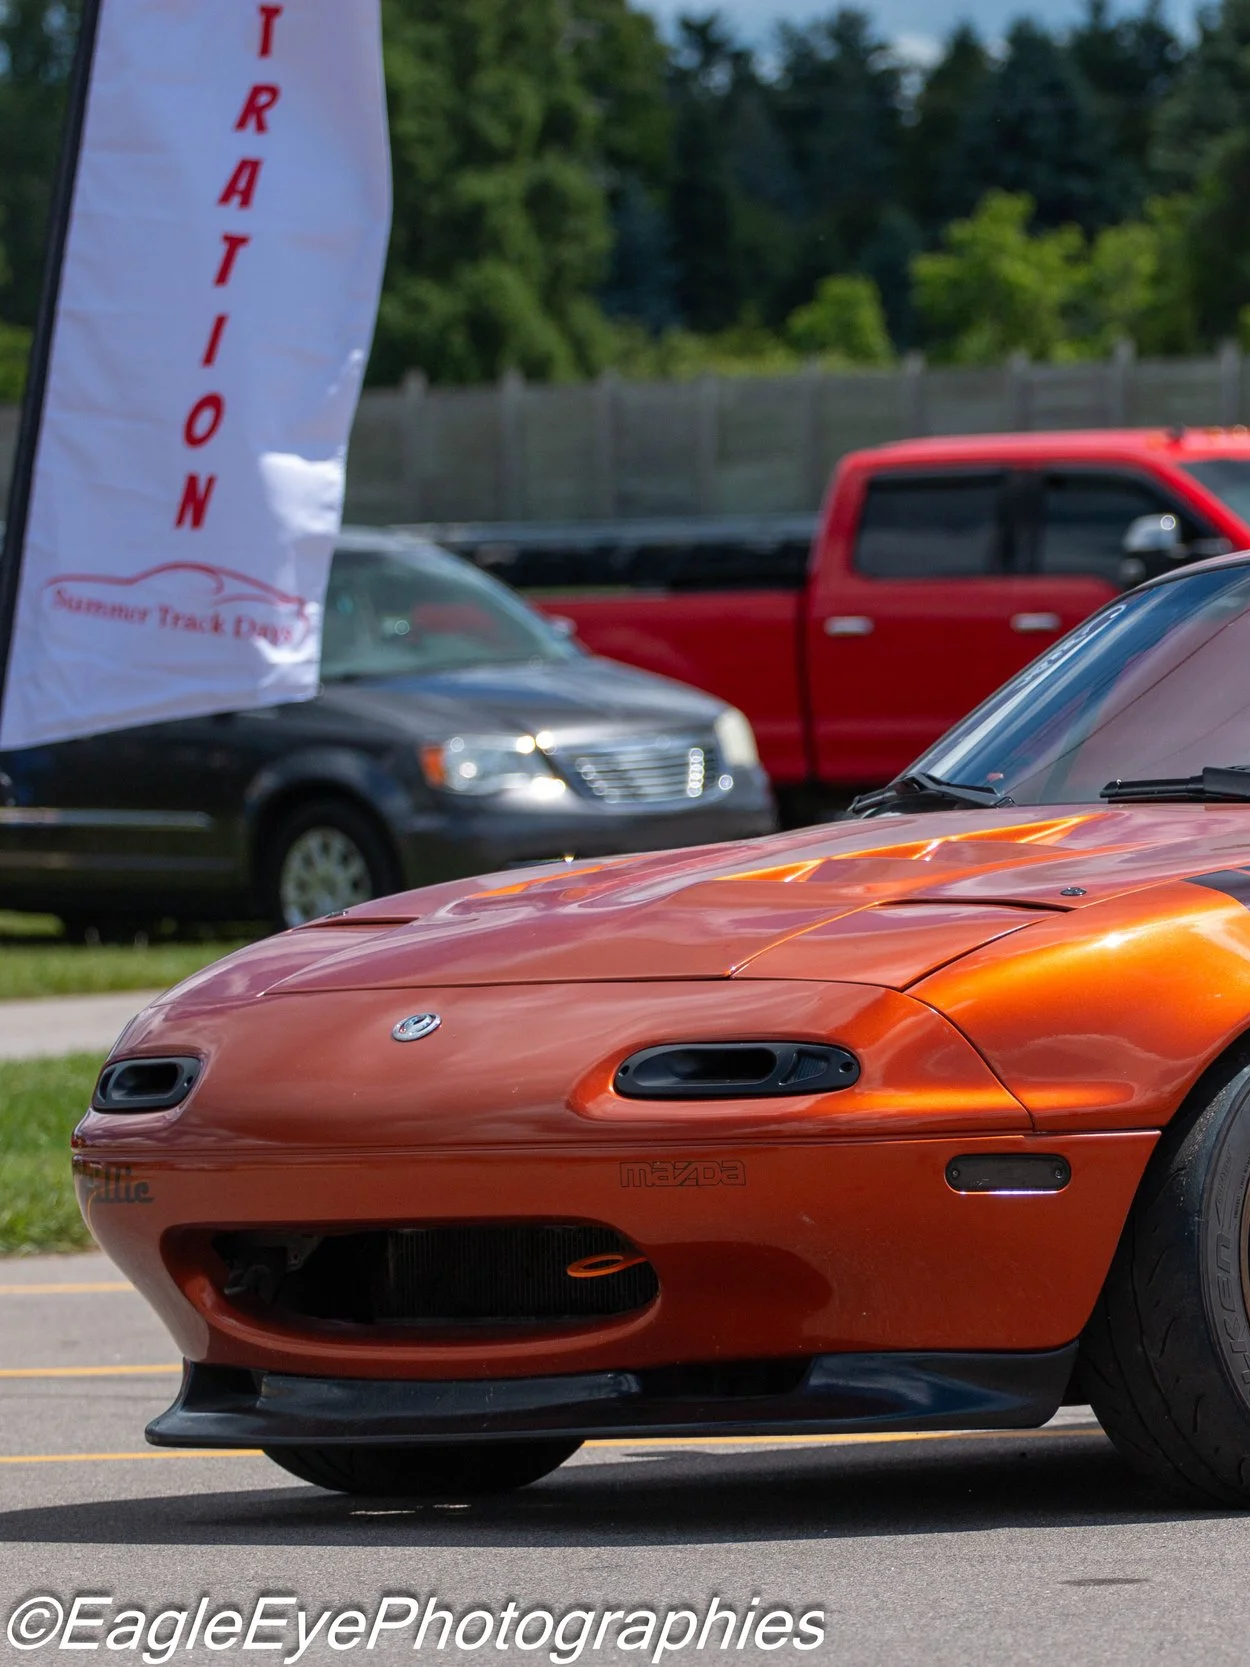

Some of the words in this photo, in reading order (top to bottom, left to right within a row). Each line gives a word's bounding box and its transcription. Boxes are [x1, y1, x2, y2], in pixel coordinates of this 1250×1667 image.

[53, 588, 150, 625] Summer
[157, 604, 225, 635] Track
[232, 615, 293, 646] Days
